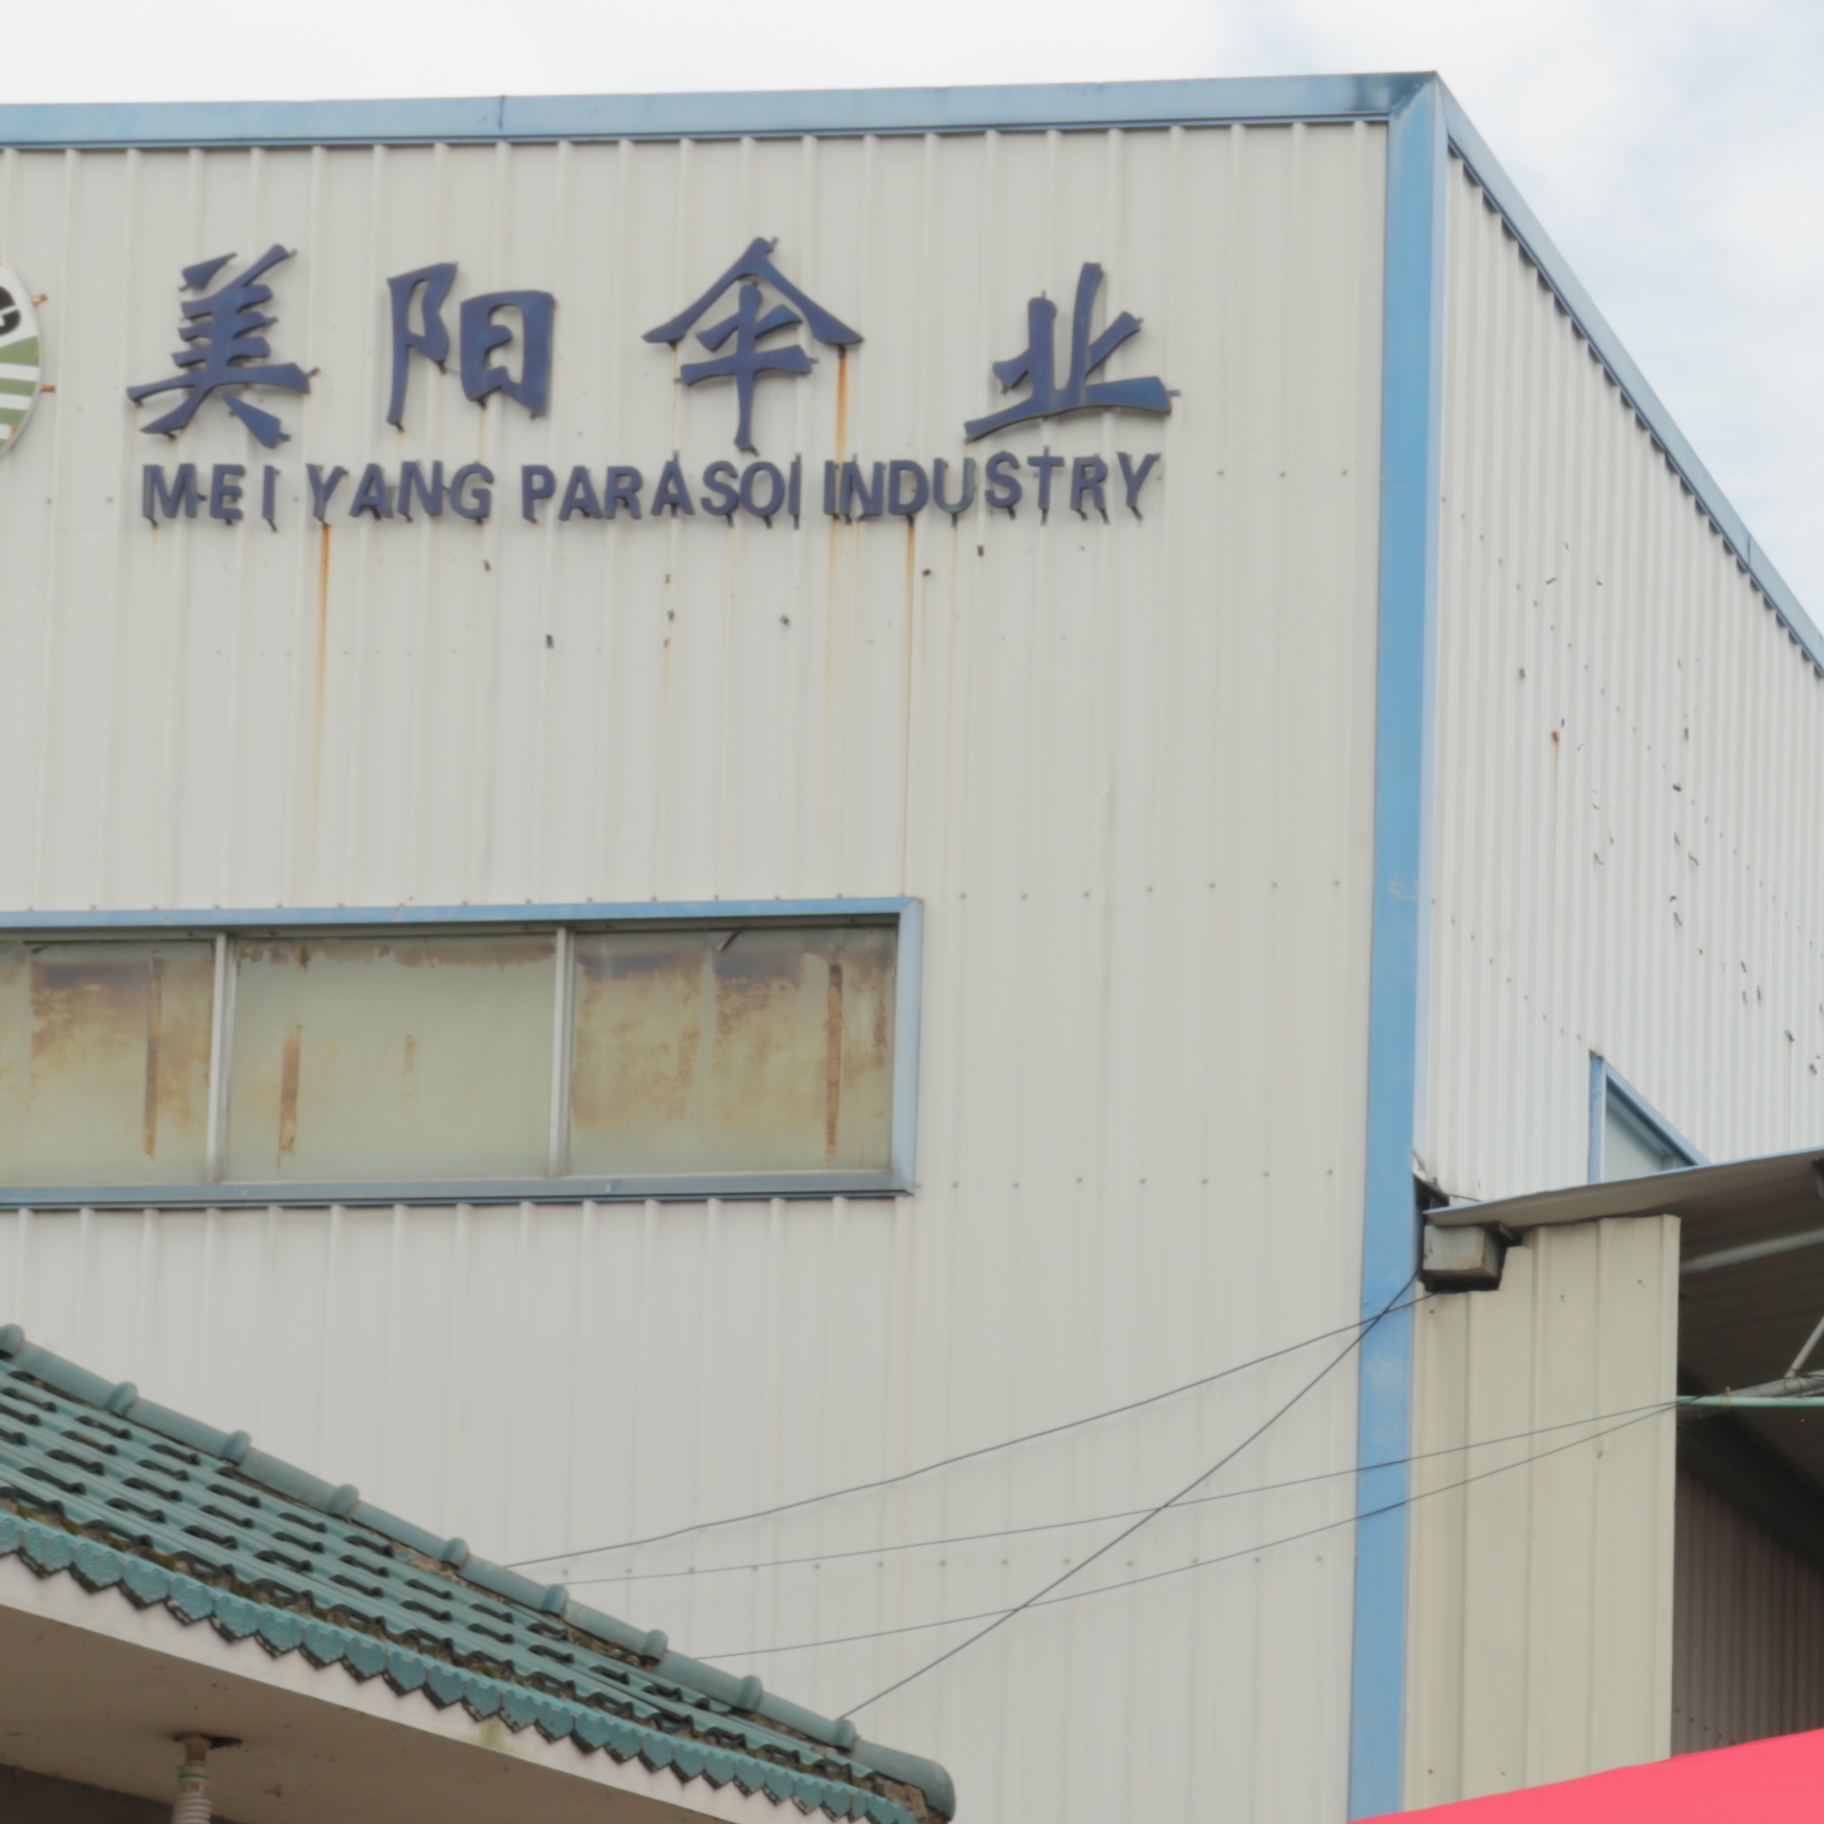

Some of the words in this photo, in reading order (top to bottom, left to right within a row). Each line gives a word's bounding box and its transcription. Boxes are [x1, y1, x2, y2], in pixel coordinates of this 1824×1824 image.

[127, 237, 1174, 450] 美阳伞业
[142, 463, 276, 522] MEI
[306, 461, 495, 522] YANG
[823, 450, 1162, 523] INDUSTRY
